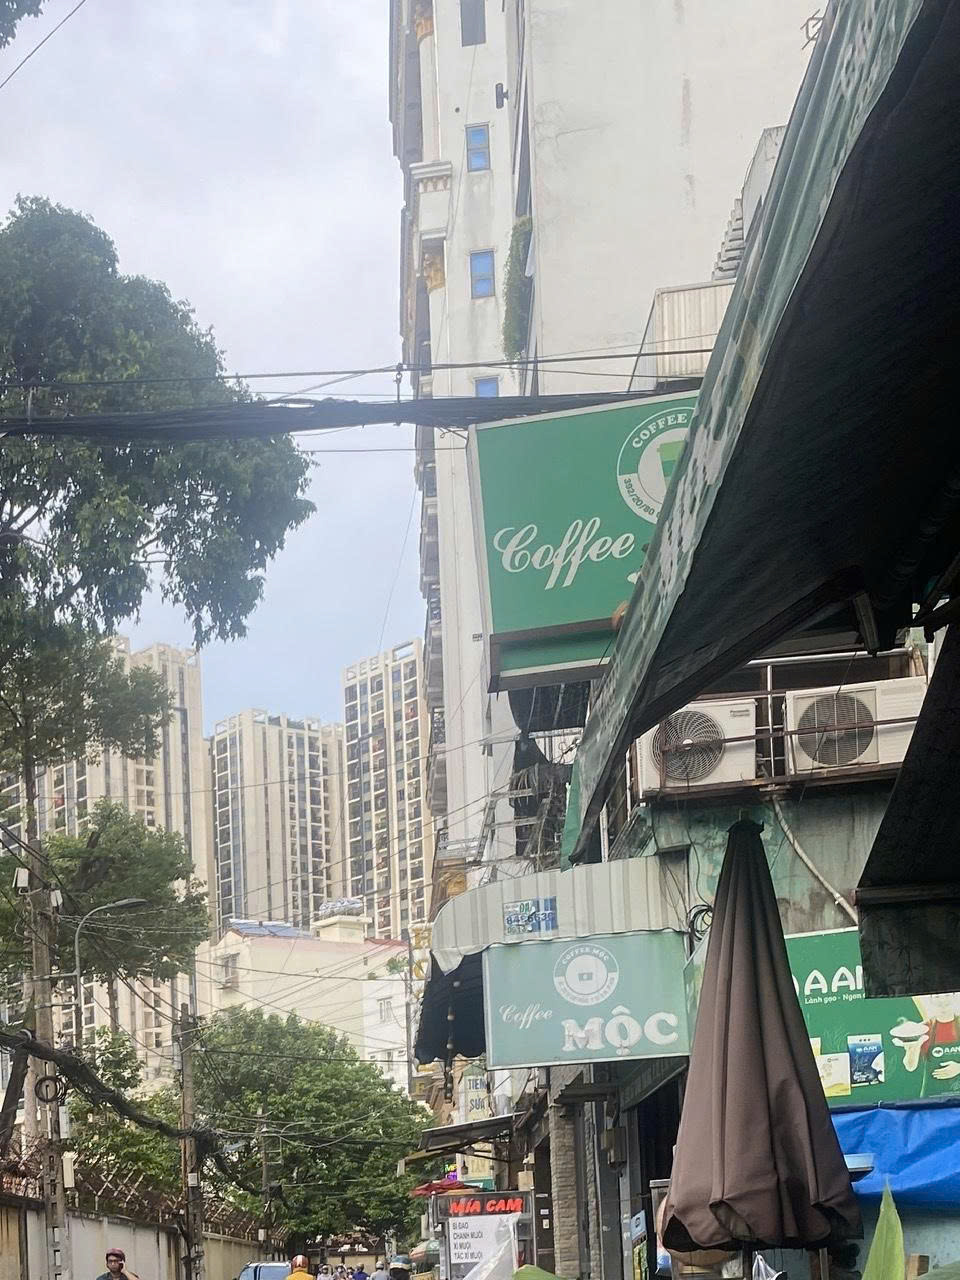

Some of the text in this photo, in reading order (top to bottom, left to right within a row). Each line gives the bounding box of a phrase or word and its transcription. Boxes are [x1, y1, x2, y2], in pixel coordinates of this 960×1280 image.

[632, 413, 688, 448] COFFEE
[493, 517, 636, 590] Coffee
[499, 1003, 679, 1056] Coffee MỘC
[486, 1197, 523, 1213] CAM
